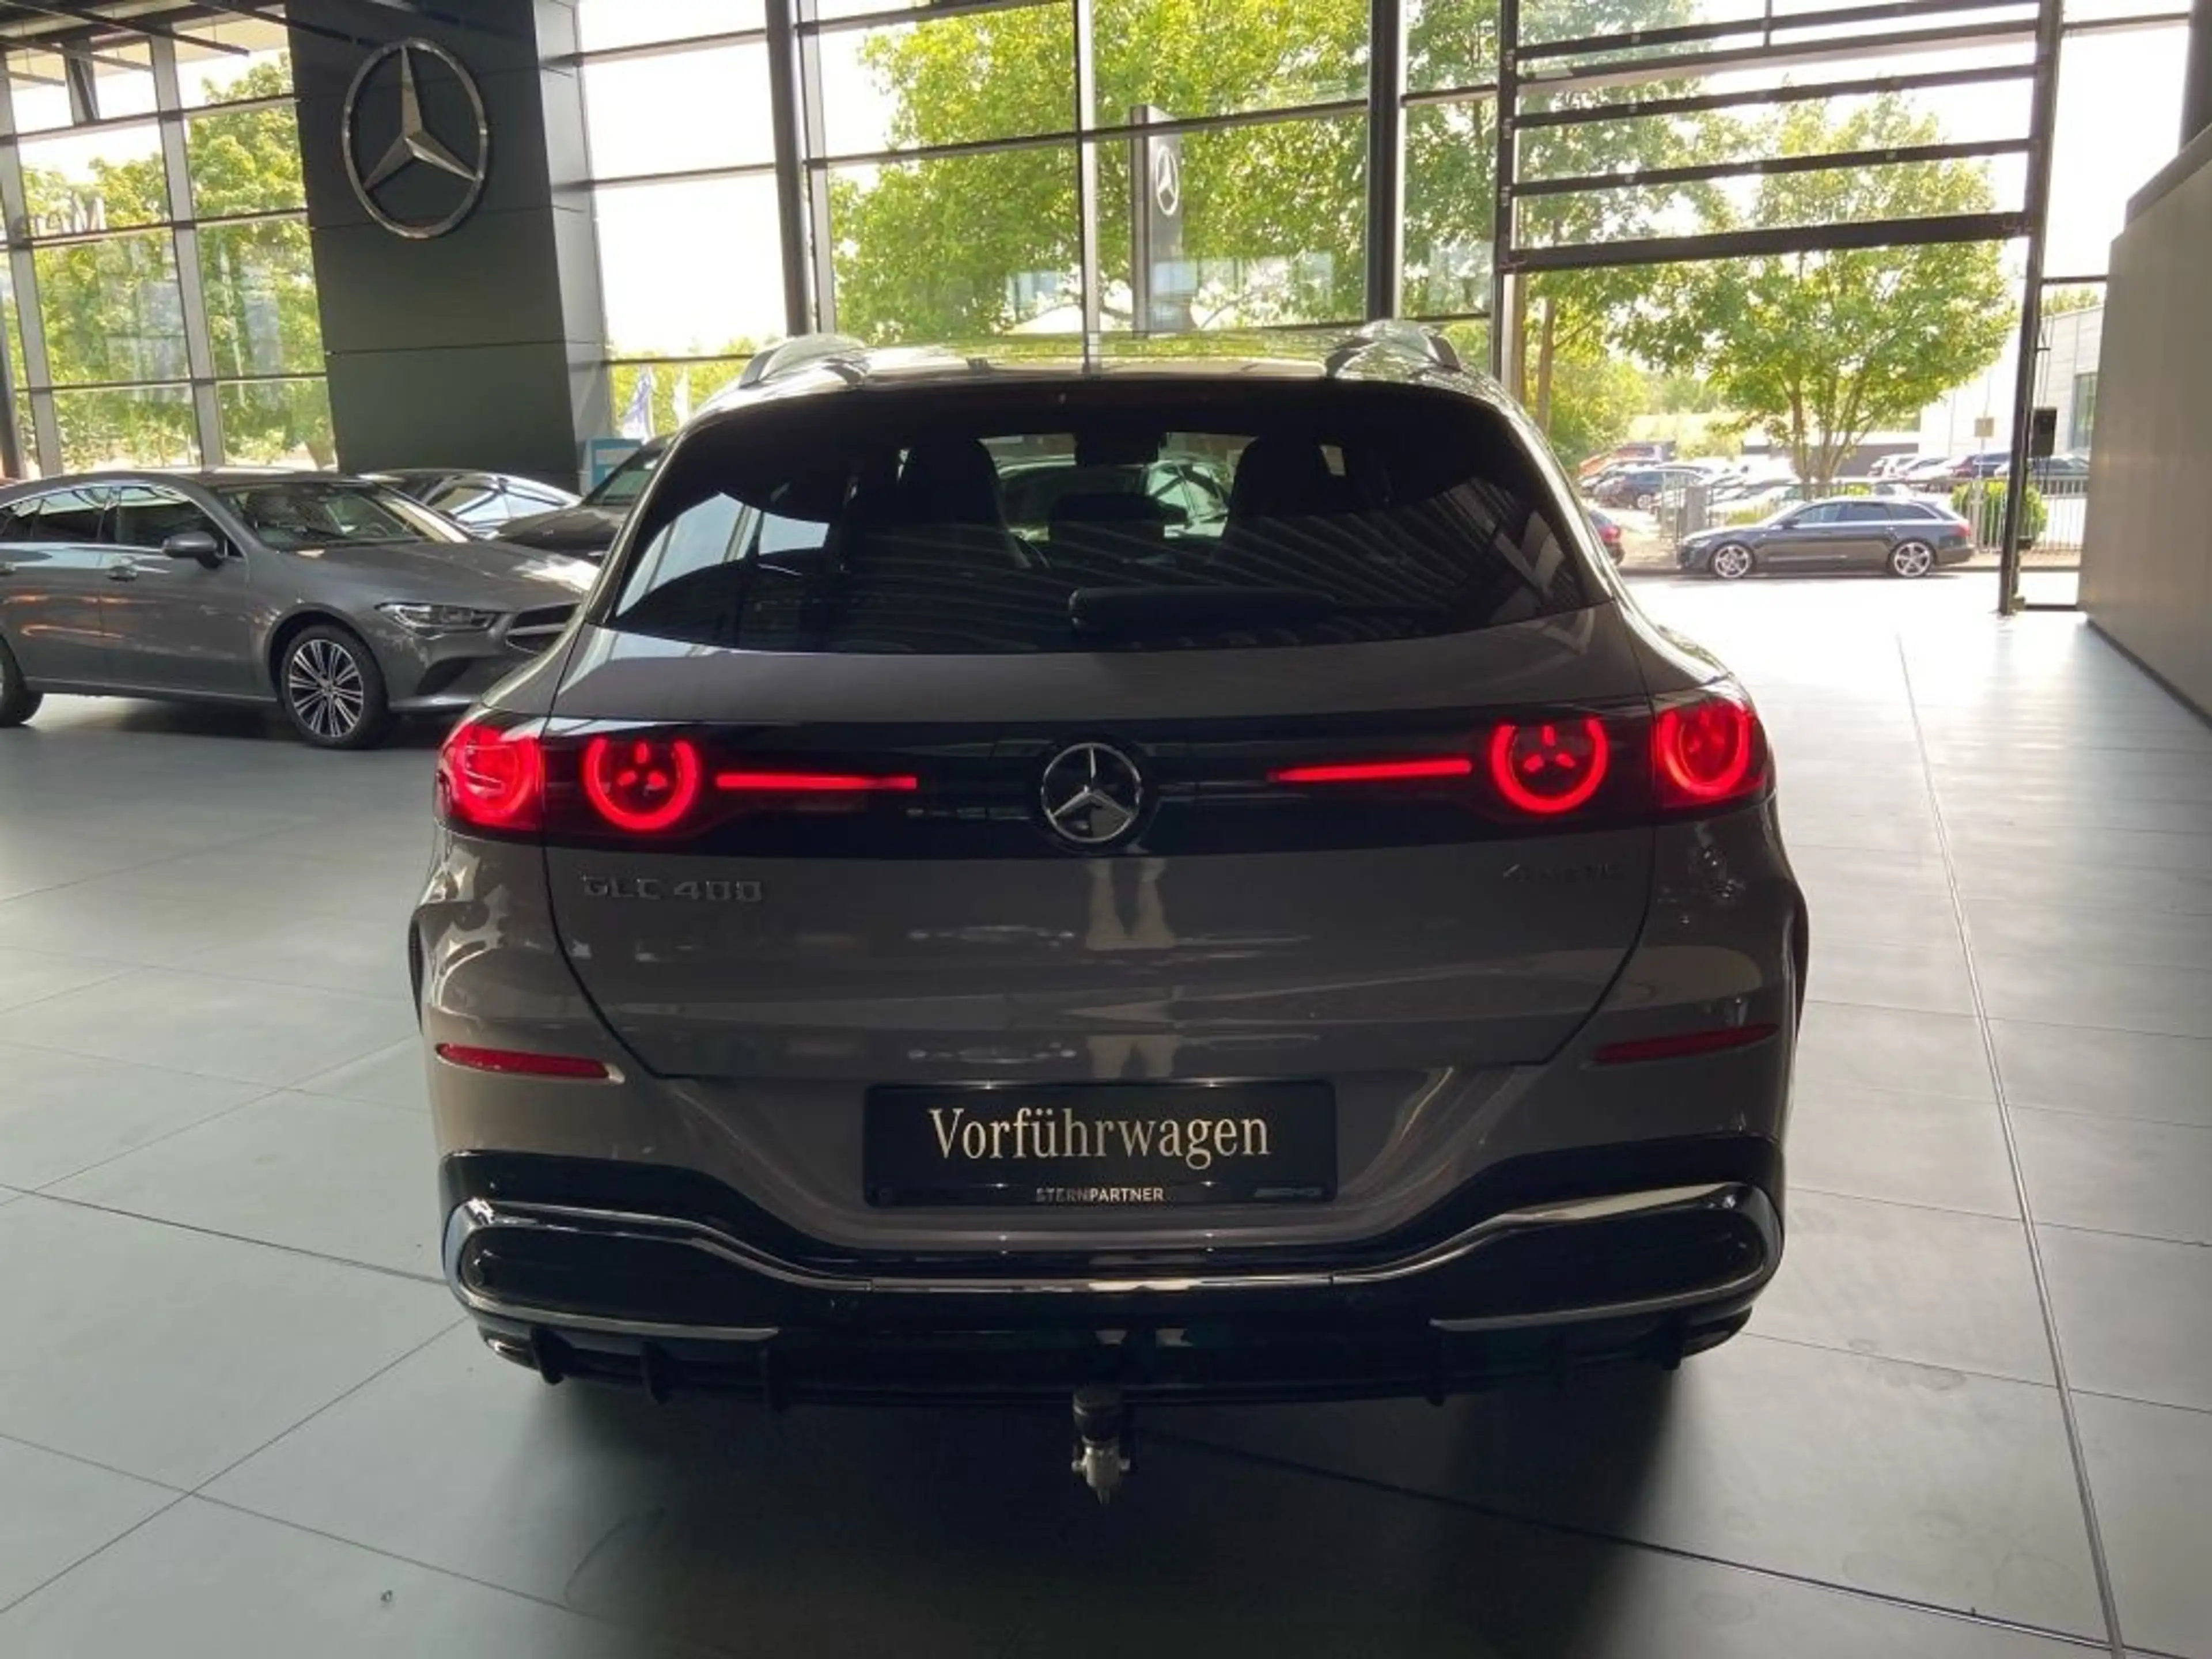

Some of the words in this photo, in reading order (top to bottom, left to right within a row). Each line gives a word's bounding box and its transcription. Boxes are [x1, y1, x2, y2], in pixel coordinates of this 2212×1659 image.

[582, 876, 660, 900] GLC
[673, 880, 762, 902] 400
[929, 1108, 1270, 1170] Vorführwagen
[1036, 1187, 1164, 1202] STERNPARTNER
